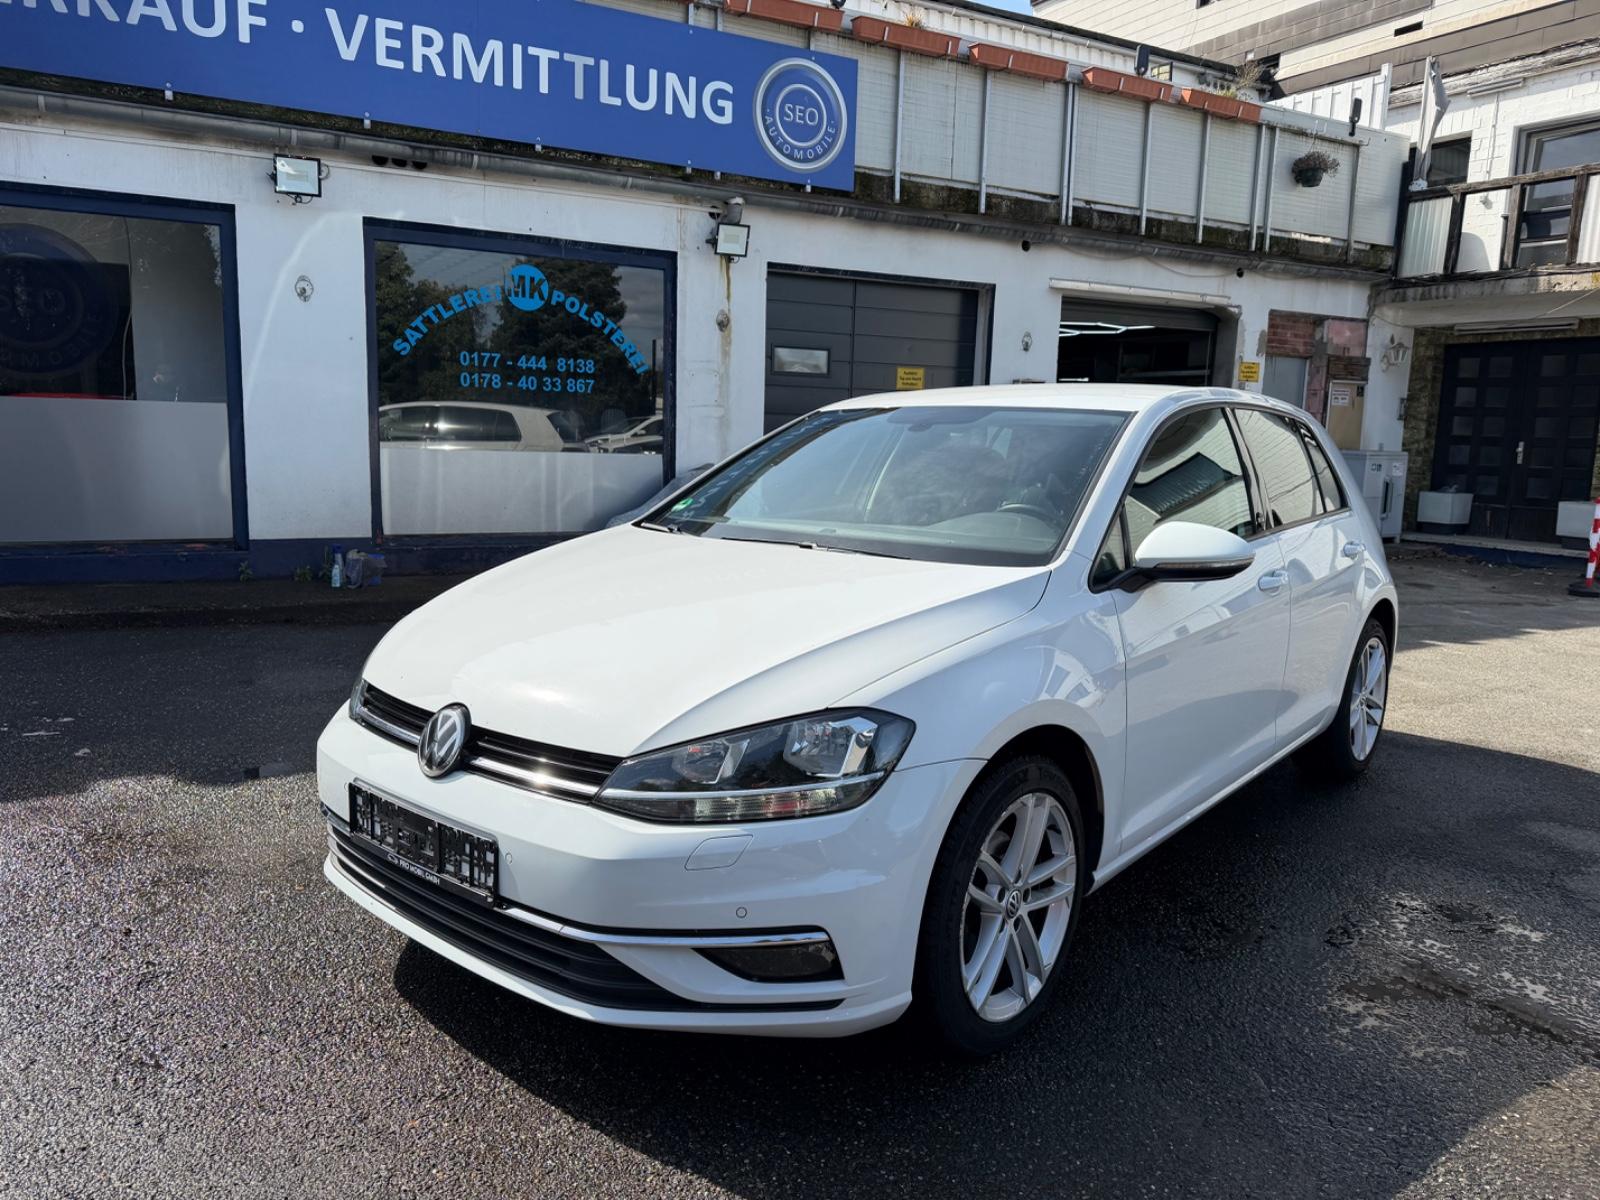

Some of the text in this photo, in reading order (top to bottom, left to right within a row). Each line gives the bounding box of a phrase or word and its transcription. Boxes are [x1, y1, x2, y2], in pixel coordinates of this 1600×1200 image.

[325, 8, 734, 125] VERMITTLUNG
[783, 103, 819, 126] SEO
[764, 115, 836, 160] AUTOMOBILE
[393, 284, 651, 375] SATTLEREI POLSTEREI
[460, 351, 501, 368] 0177
[517, 354, 548, 371] 444
[557, 357, 595, 374] 8138
[460, 372, 502, 389] 0178
[517, 375, 538, 391] 40
[542, 377, 561, 392] 33
[567, 378, 595, 394] 867
